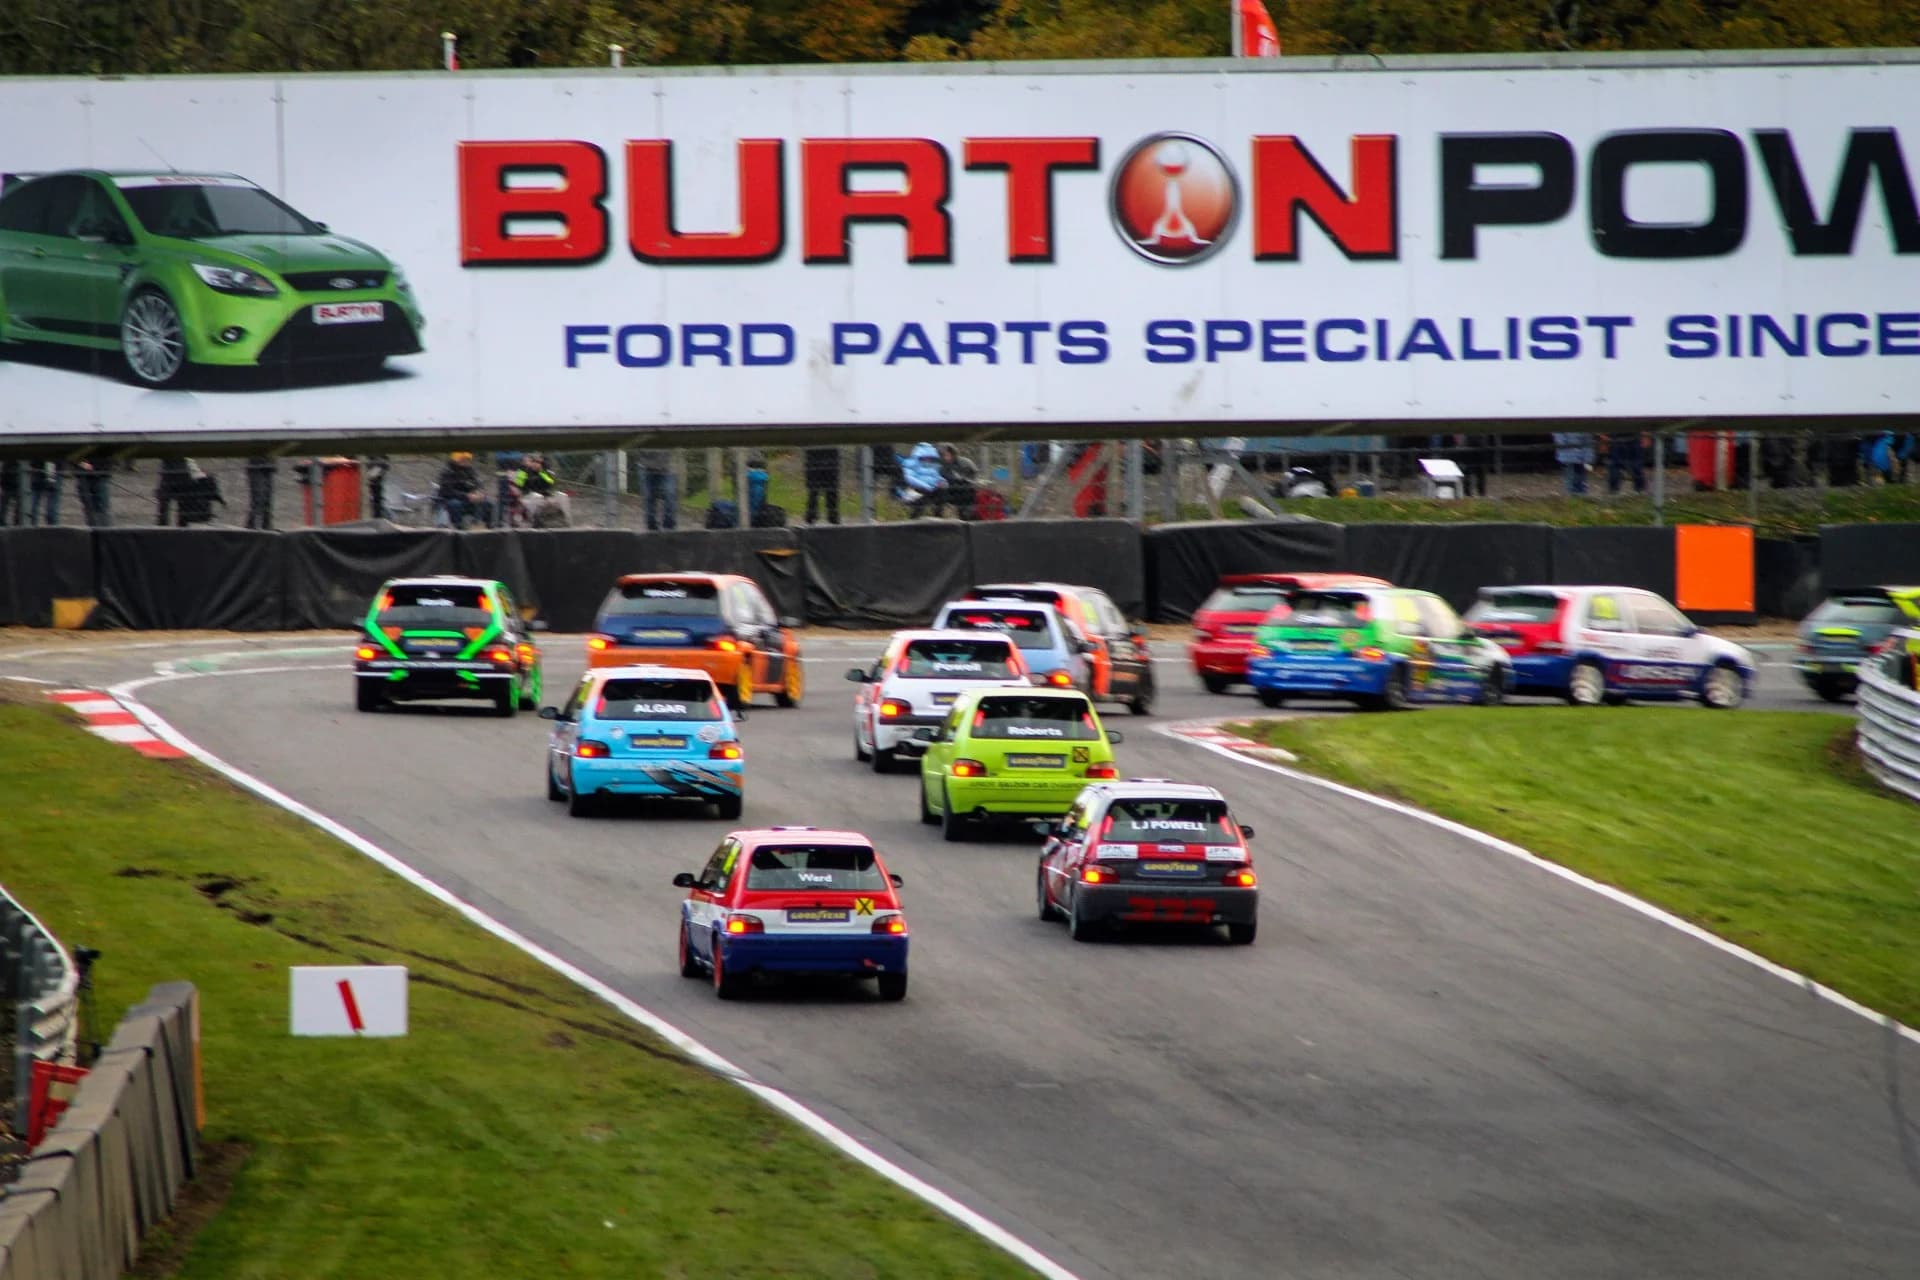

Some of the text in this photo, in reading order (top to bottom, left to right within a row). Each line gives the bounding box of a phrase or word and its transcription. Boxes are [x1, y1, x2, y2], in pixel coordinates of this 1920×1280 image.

[458, 129, 1399, 270] BURTON
[565, 312, 1920, 368] FORD PARTS SPECIALIST SINCE
[633, 703, 687, 714] ALGAR
[1007, 726, 1063, 737] Roberts
[1150, 820, 1207, 831] POWELL
[798, 872, 833, 882] Ward
